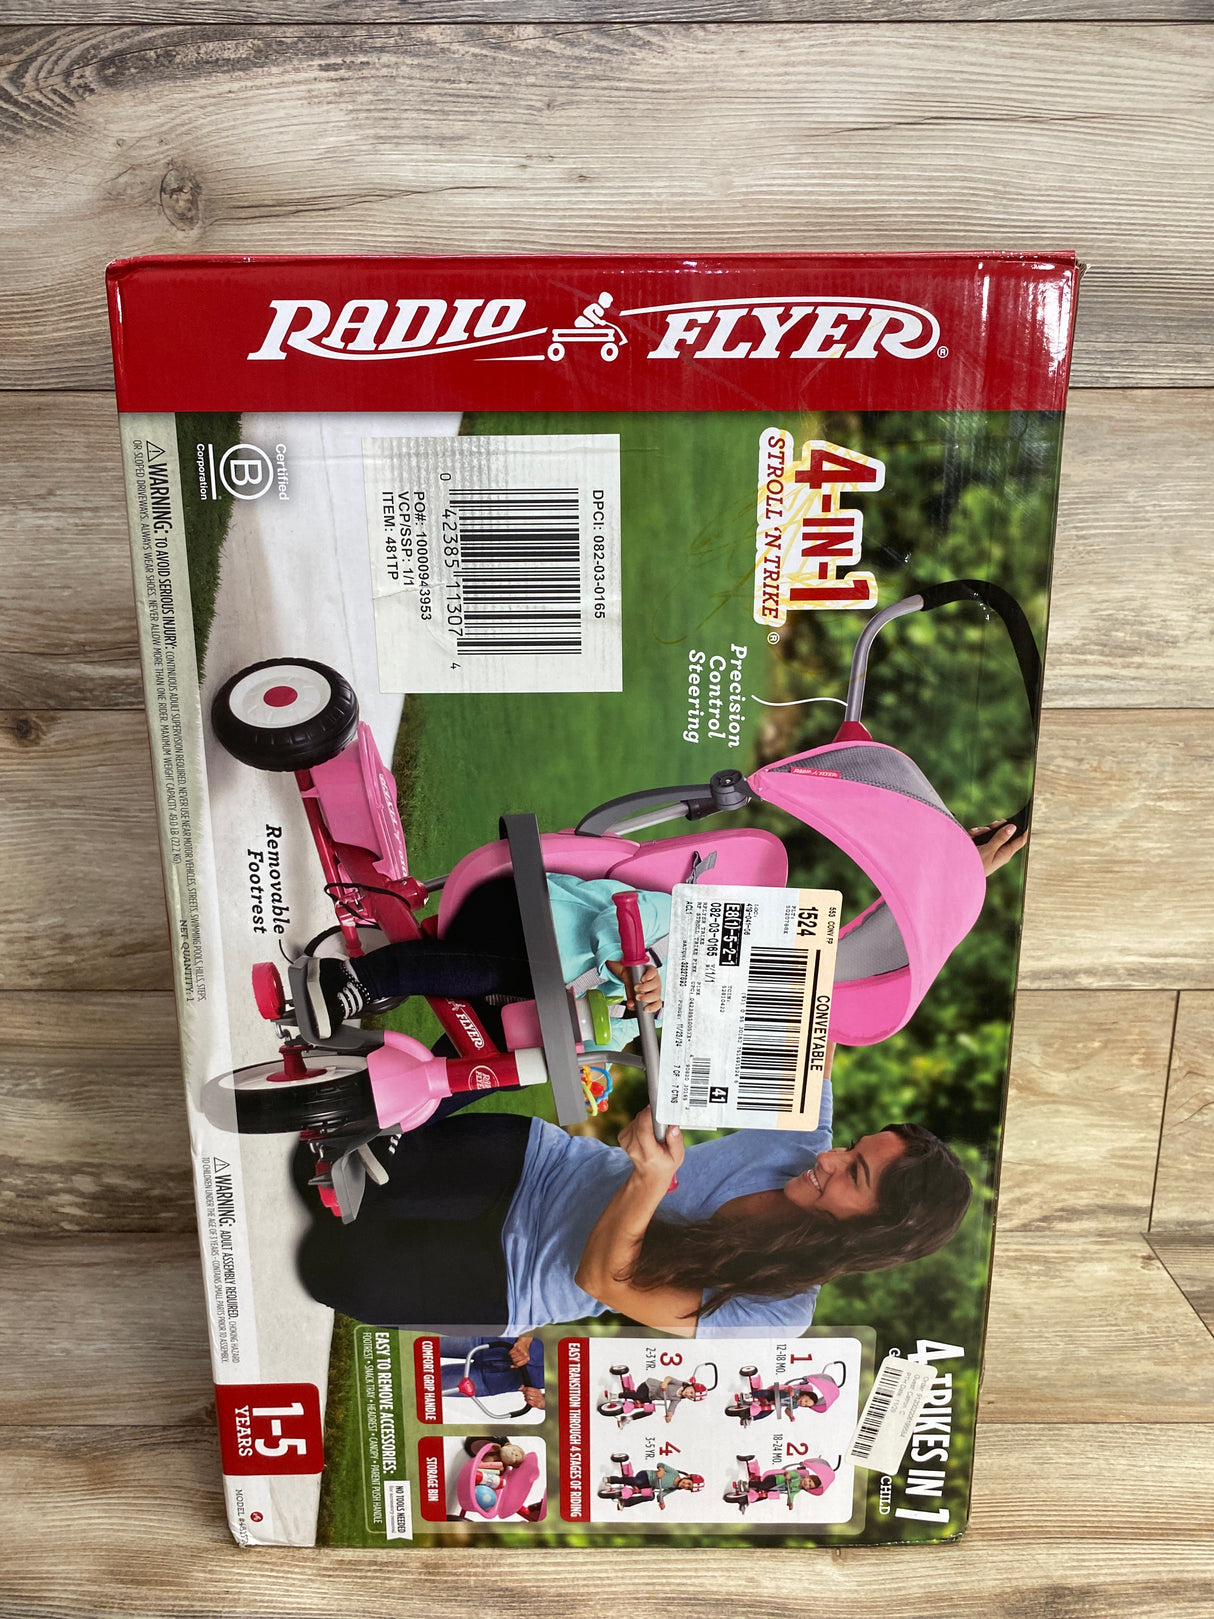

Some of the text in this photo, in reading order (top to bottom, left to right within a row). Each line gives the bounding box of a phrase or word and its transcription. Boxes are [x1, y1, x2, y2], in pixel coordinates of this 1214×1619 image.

[246, 296, 942, 361] RADIO FLYER
[133, 440, 142, 450] OR
[134, 452, 145, 477] SLOPED
[196, 444, 208, 500] Corporation
[230, 460, 262, 486] B
[276, 444, 289, 500] Certified
[765, 436, 785, 519] STROLL
[136, 480, 149, 521] DRIVEWAYS.
[148, 462, 172, 534] WARNING:
[141, 523, 152, 550] ALWAYS
[383, 492, 399, 580] ITEM: 481TP
[789, 449, 878, 601] 4-IN-1
[155, 538, 168, 548] TO
[398, 491, 414, 586] VCP/SSP: 1/1
[143, 552, 155, 573] WEAR
[156, 550, 171, 576] AVOID
[413, 491, 432, 621] PO#: 10000943953
[592, 490, 605, 619] DPCI: 082-03-0165
[159, 579, 175, 614] SERIOUS
[762, 555, 781, 619] TRIKE
[148, 600, 159, 621] NEVER
[150, 623, 161, 646] ALLOW
[163, 616, 177, 649] INJURY:
[153, 647, 163, 666] MORE
[154, 668, 165, 686] THAN
[165, 651, 177, 691] CONTINUOUS
[156, 688, 167, 701] ONE
[169, 692, 180, 712] ADULT
[683, 649, 705, 744] Steering
[708, 656, 726, 738] Control
[728, 644, 748, 747] Precision
[158, 703, 169, 723] RIDER.
[160, 725, 173, 756] MAXIMUM
[171, 713, 184, 753] SUPERVISION
[163, 757, 176, 781] WEIGHT
[175, 754, 186, 785] REQUIRED.
[166, 783, 178, 811] CAPACITY
[178, 787, 189, 806] NEVER
[169, 813, 179, 826] 49.0
[180, 808, 190, 819] USE
[170, 827, 180, 835] LB
[181, 820, 192, 837] NEAR
[170, 836, 182, 852] (22.2
[183, 837, 194, 858] MOTOR
[185, 859, 196, 887] VEHICLES,
[266, 824, 290, 934] Removable
[187, 888, 199, 913] STREETS,
[247, 849, 267, 934] Footrest
[685, 901, 693, 915] ACL1
[828, 907, 836, 917] 553
[179, 920, 189, 940] NET
[190, 914, 202, 944] SWIMMING
[707, 902, 721, 956] 082-03-0165
[797, 907, 819, 936] 1524
[827, 921, 835, 936] CONV
[193, 945, 204, 965] POOLS,
[180, 941, 193, 996] QUANTITY:
[455, 1013, 485, 1049] FLYER
[810, 995, 830, 1071] CONVEYABLE
[712, 1088, 726, 1102] 41
[202, 1164, 213, 1188] CHILDREN
[205, 1190, 215, 1206] UNDER
[206, 1208, 215, 1217] THE
[208, 1218, 216, 1228] AGE
[210, 1240, 219, 1256] YEARS
[211, 1260, 221, 1284] CONTAINS
[215, 1175, 240, 1363] WARNING: ADULT ASSEMBLY REQUIRED. CHOKING HAZARD
[213, 1285, 223, 1299] SMALL
[215, 1300, 224, 1315] PARTS
[216, 1316, 226, 1330] PRIOR
[218, 1339, 229, 1363] ASSEMBLY.
[568, 1343, 580, 1361] EASY
[645, 1347, 656, 1370] 2-3 YR.
[660, 1352, 683, 1366] 3
[775, 1344, 787, 1375] 12-18 MO.
[790, 1353, 813, 1364] 1
[907, 1340, 965, 1364] 4
[422, 1341, 436, 1420] COMFORT GRIP HANDLE
[568, 1364, 580, 1407] TRANSITION
[375, 1332, 397, 1474] EASY TO REMOVE ACCESSORIES:
[252, 1402, 307, 1457] 1-5
[362, 1332, 383, 1523] FOOTREST SNACK TRAY HEADREST CANOPY PARENT PUSH HANDLE
[569, 1409, 581, 1445] THROUGH
[910, 1373, 952, 1462] TRIKES
[235, 1405, 253, 1457] YEARS
[645, 1437, 656, 1460] 3-5 YR.
[659, 1441, 681, 1456] 4
[772, 1434, 783, 1465] 18-24 MO.
[787, 1442, 808, 1456] 2
[570, 1453, 581, 1478] STAGES
[426, 1457, 438, 1501] STORAGE BIN
[570, 1480, 581, 1490] OF
[905, 1469, 945, 1497] IN
[236, 1489, 244, 1516] MODEL
[570, 1491, 582, 1517] RIDING
[879, 1476, 892, 1515] CHILD
[396, 1486, 406, 1533] NO TOOLS NEEDED
[895, 1508, 950, 1523] 1
